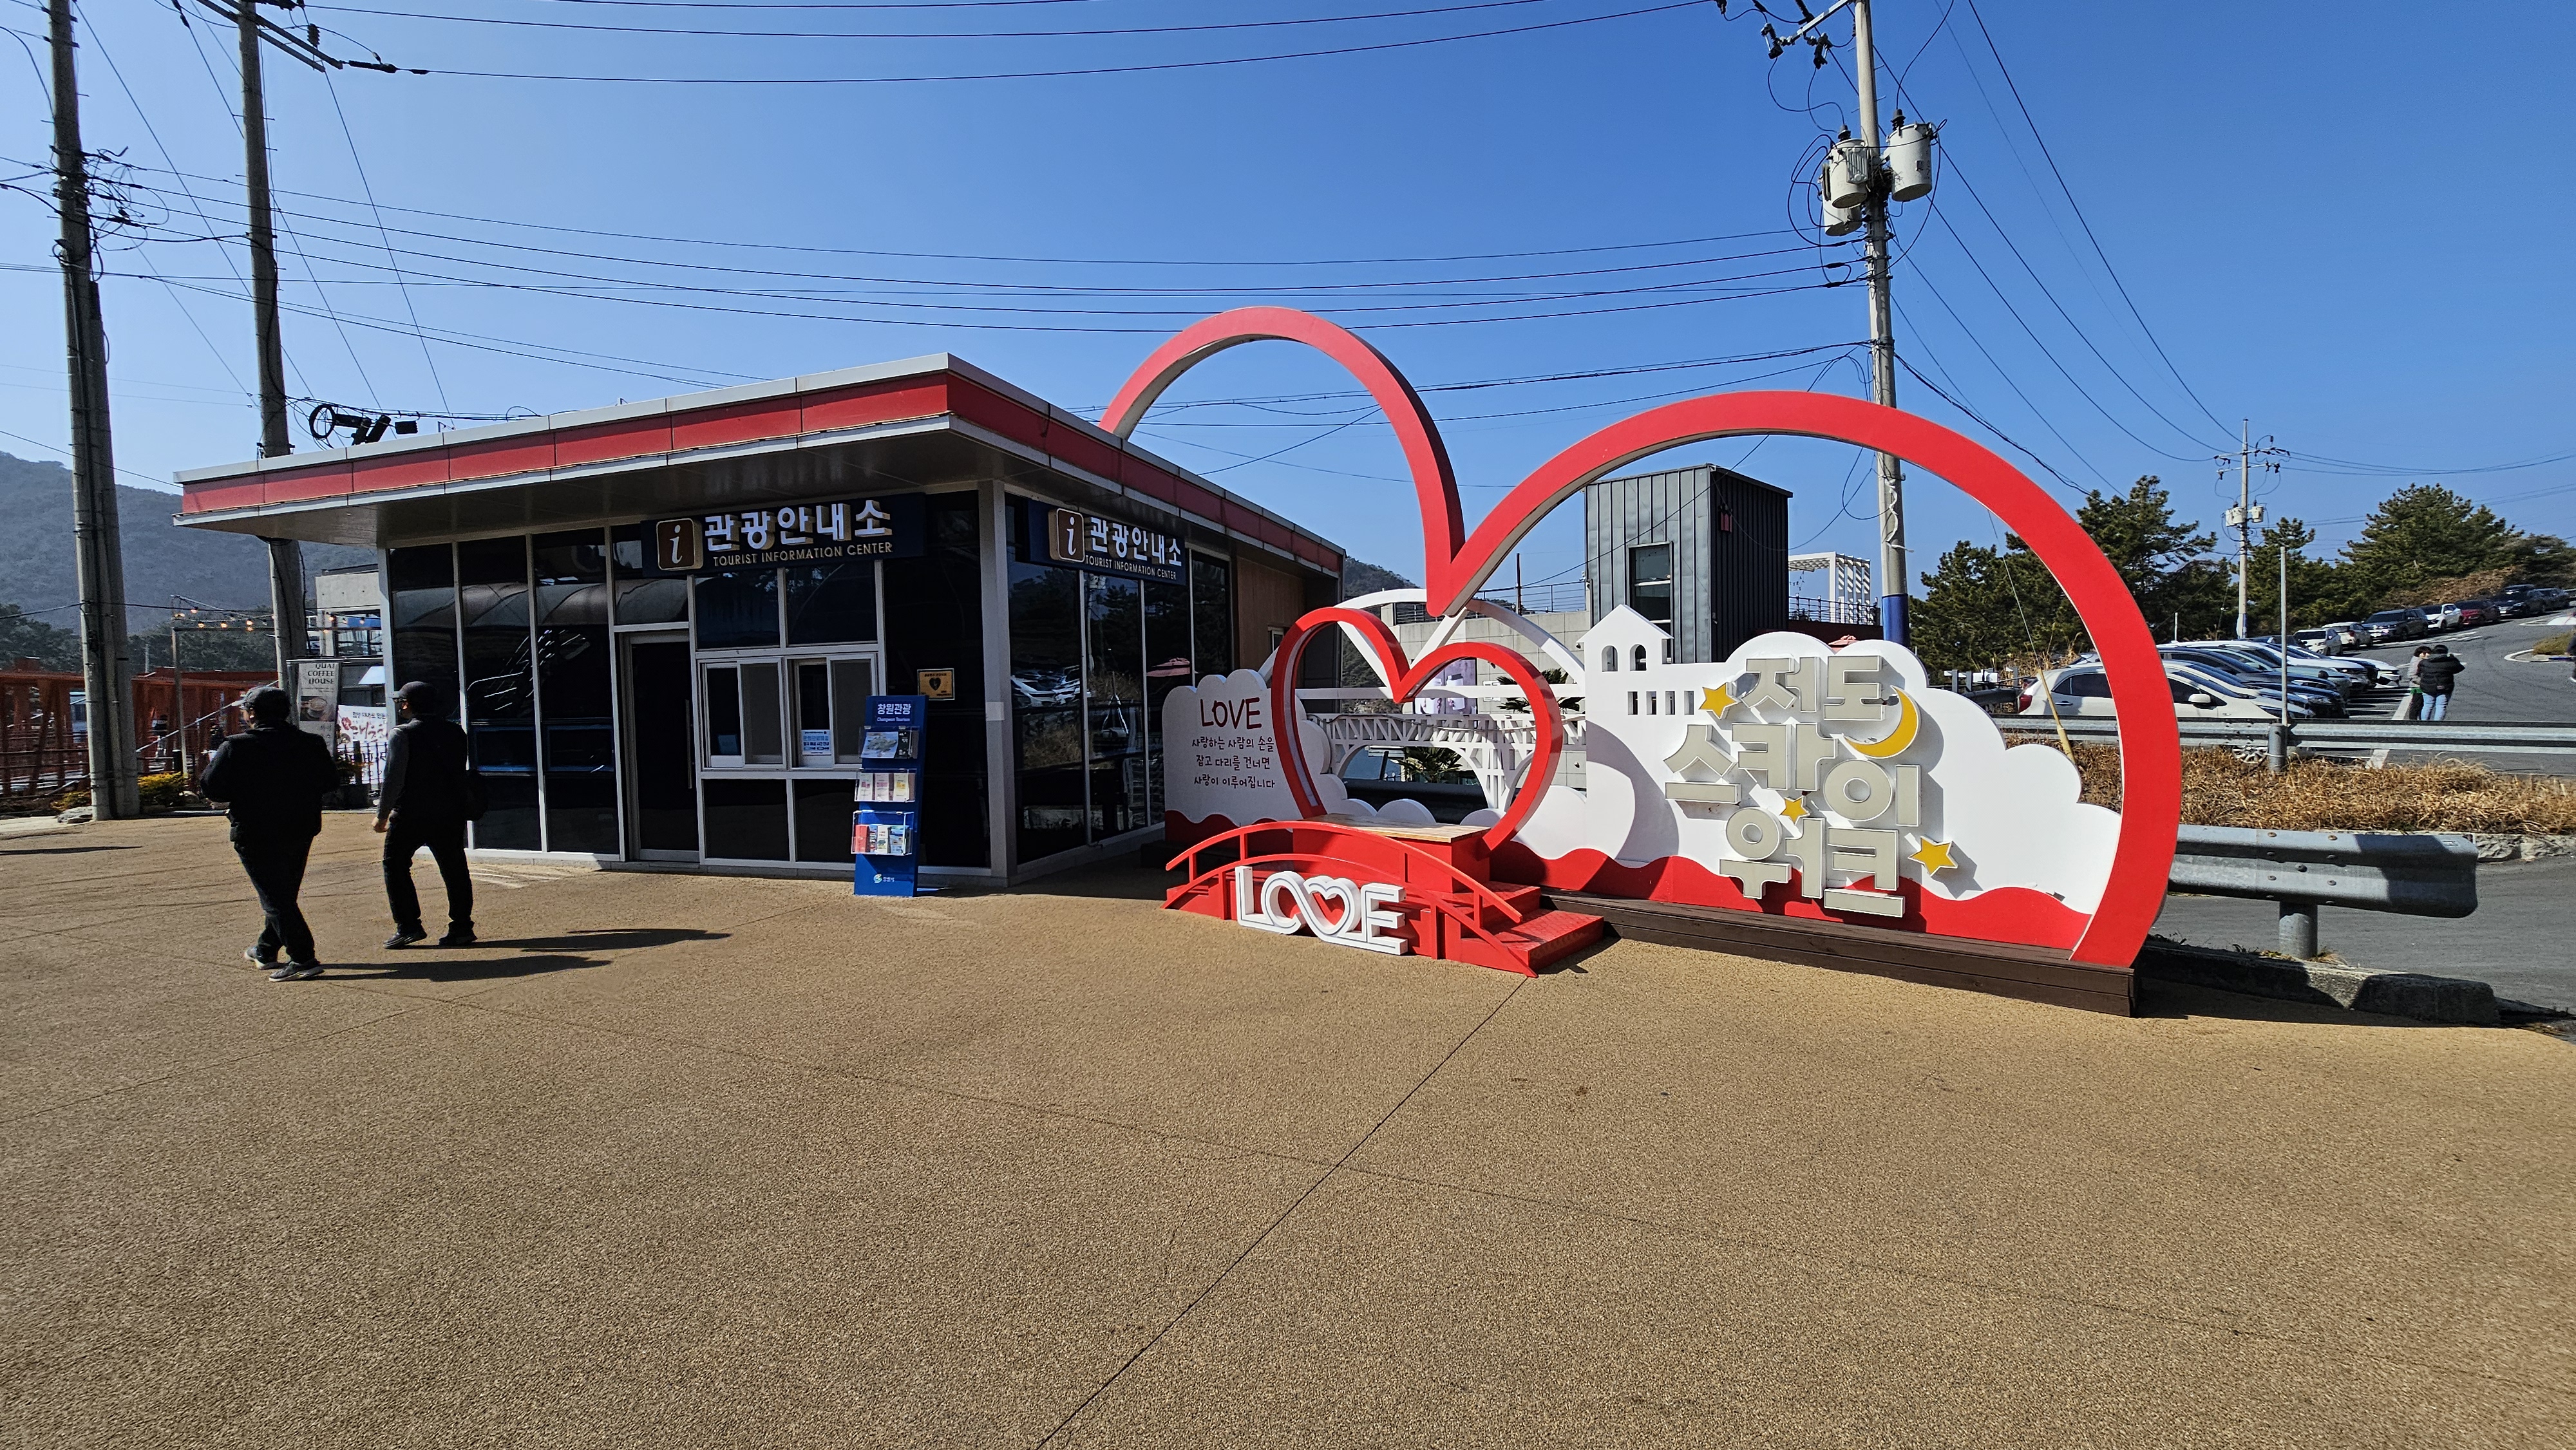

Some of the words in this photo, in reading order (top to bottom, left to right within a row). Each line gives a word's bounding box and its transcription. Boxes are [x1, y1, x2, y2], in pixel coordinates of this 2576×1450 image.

[705, 500, 893, 552] 관광안내소
[713, 553, 757, 567] TOURIST
[761, 547, 842, 562] INFORMATION
[847, 542, 892, 556] CENTER
[1090, 517, 1182, 567] 관광안내소
[1085, 554, 1112, 569] TOURIST
[1114, 561, 1155, 576] INFORMATION
[1157, 569, 1177, 580] CENTER
[1741, 655, 1885, 720] 저도
[877, 703, 912, 715] 창원관광
[1200, 697, 1262, 730] LOVE
[1192, 737, 1225, 750] 사랑하는
[1228, 737, 1254, 749] 사람의
[1258, 736, 1274, 752] 손을
[1196, 755, 1212, 767] 잡고
[1215, 755, 1240, 771] 다리를
[1244, 757, 1270, 769] 건너면
[1663, 722, 1921, 827] 스카이
[1194, 774, 1219, 786] 사랑이
[1222, 776, 1275, 789] 이루어집니다
[1719, 807, 1905, 918] 워크
